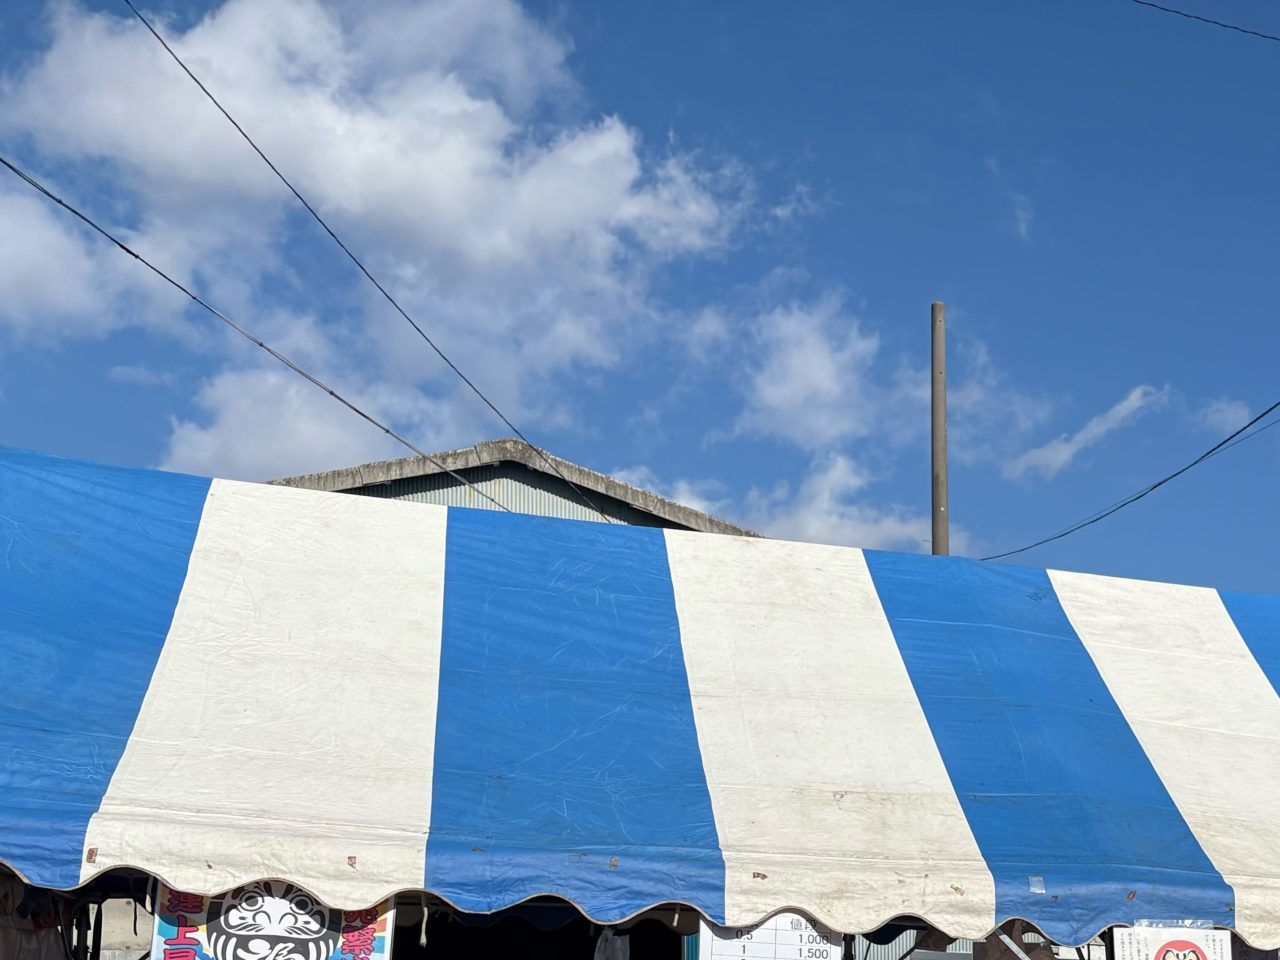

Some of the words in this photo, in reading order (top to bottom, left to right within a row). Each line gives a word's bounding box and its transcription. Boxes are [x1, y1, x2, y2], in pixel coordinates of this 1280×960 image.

[799, 934, 829, 945] 1,000
[742, 945, 746, 954] 1
[799, 949, 829, 959] 1,500
